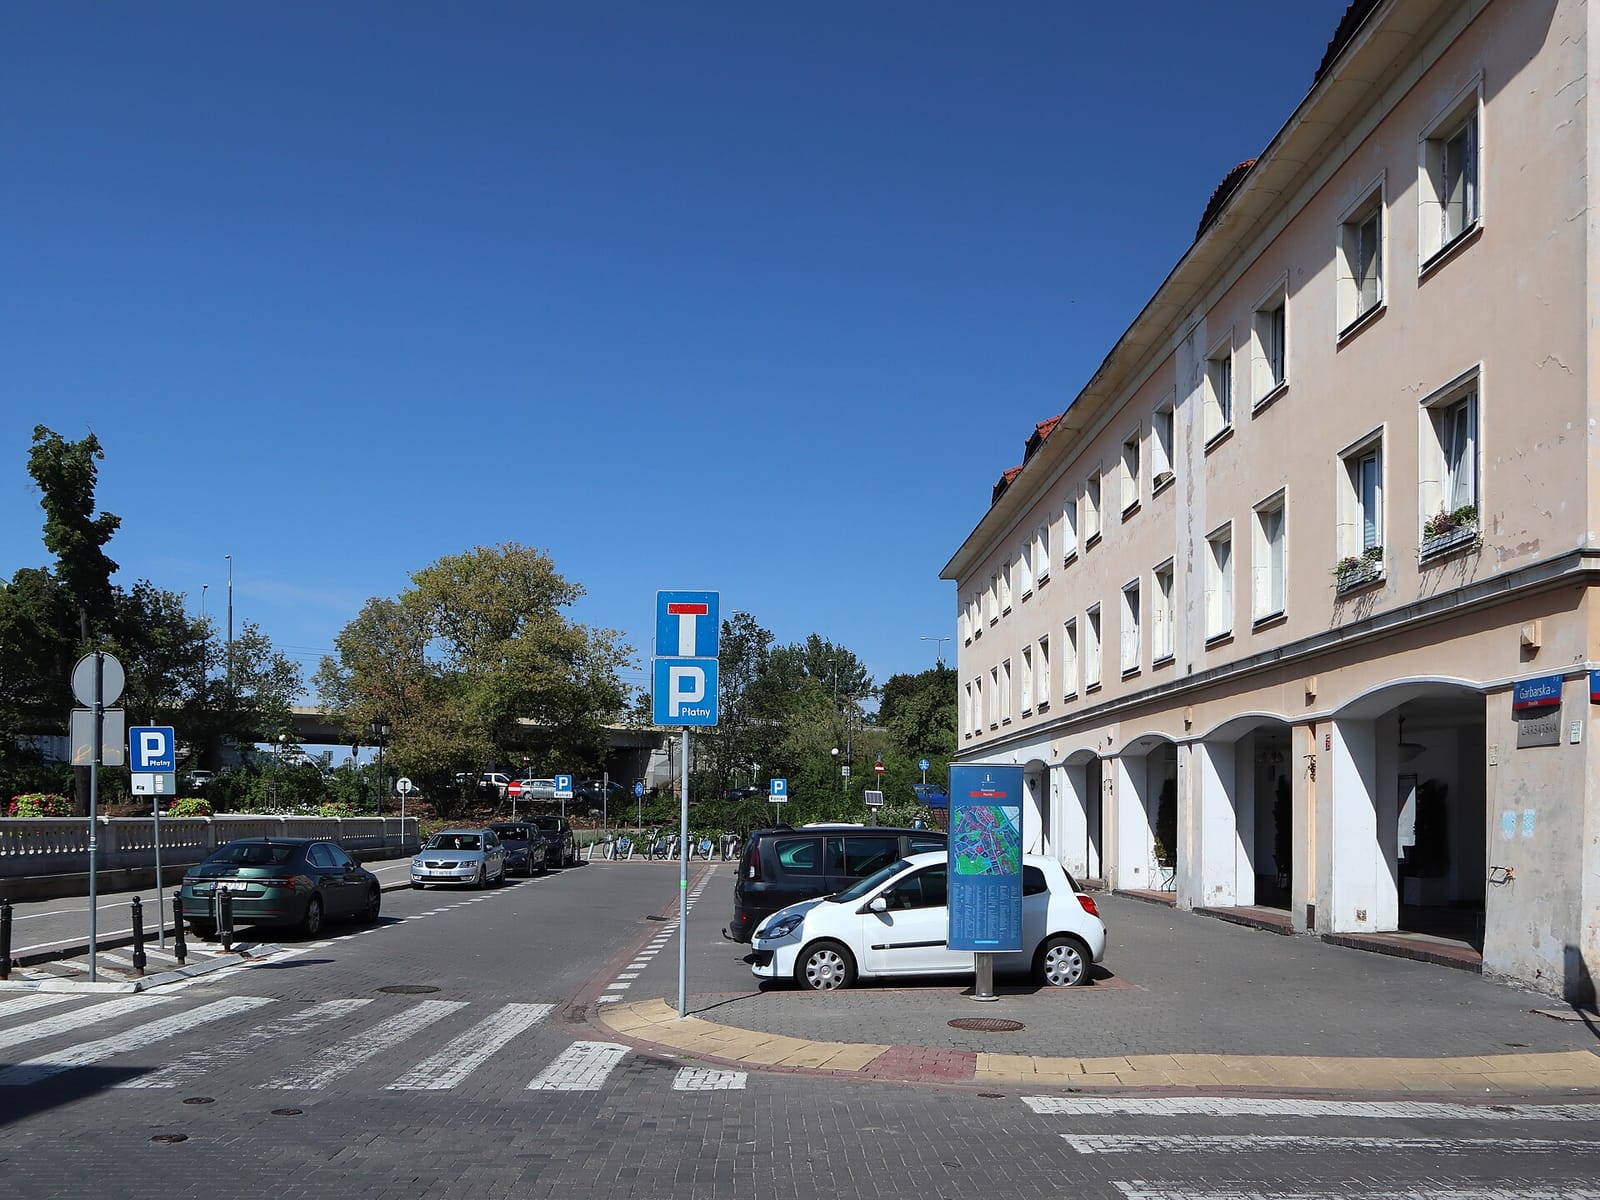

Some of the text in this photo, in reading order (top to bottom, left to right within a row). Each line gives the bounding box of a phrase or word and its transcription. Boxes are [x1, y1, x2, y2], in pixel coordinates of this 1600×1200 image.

[669, 666, 705, 717] P
[1519, 684, 1551, 699] Garbarska
[682, 707, 710, 718] Płatny
[140, 732, 165, 767] P
